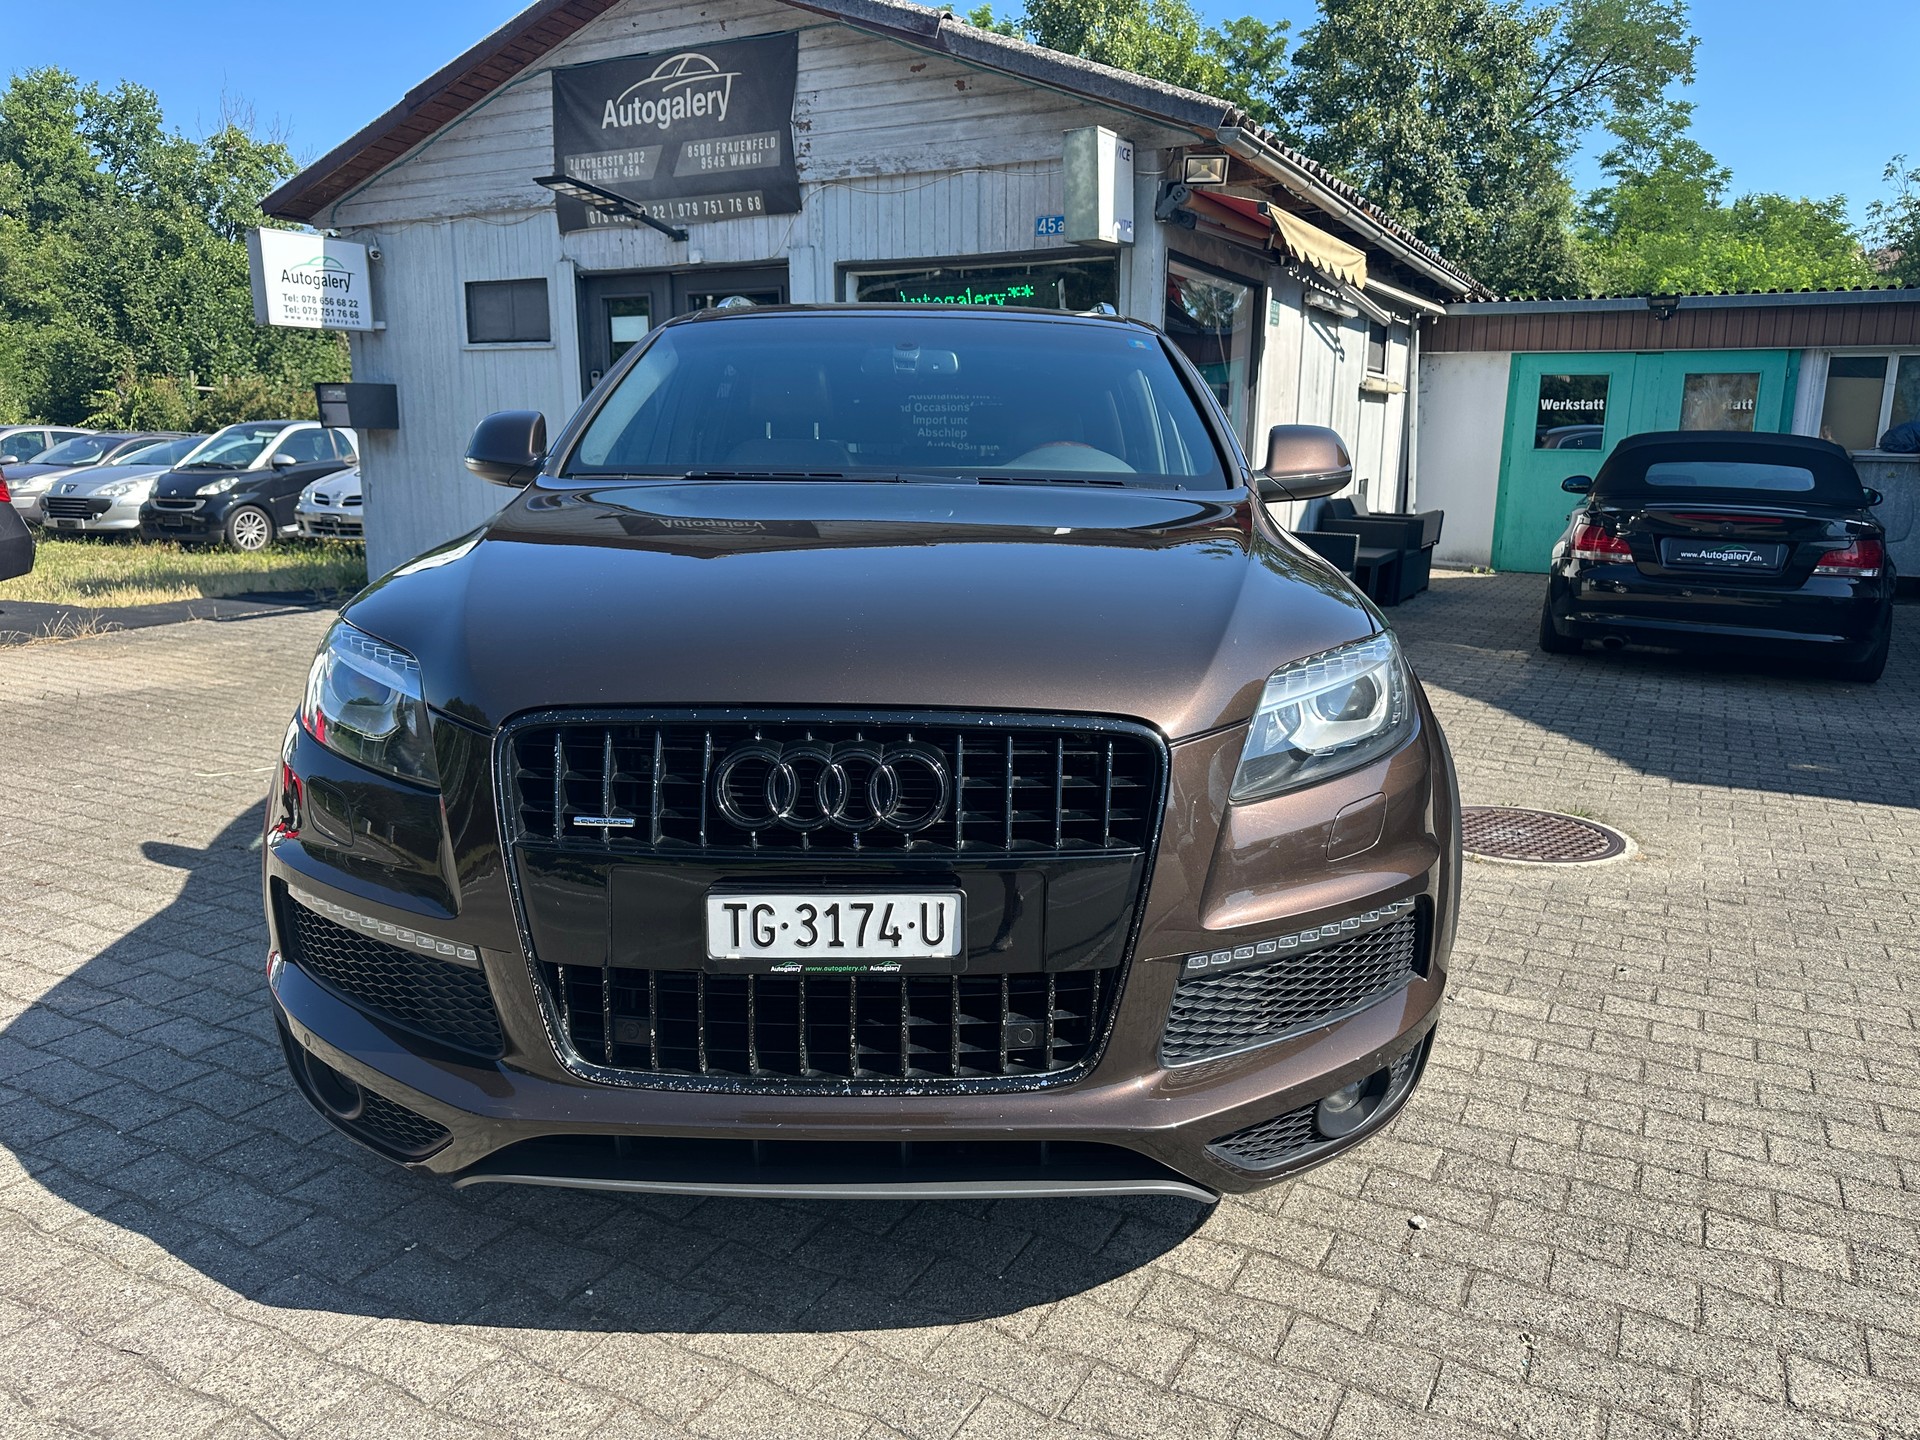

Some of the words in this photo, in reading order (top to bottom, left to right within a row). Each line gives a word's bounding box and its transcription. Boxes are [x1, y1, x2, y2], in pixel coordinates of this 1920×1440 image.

[602, 78, 733, 129] Autogalery
[687, 144, 711, 158] 8500
[716, 136, 776, 155] FRAUENFELD
[628, 151, 645, 164] 302
[701, 155, 725, 170] 9545
[730, 150, 762, 166] WÄNGI
[575, 168, 619, 181] WILERSTR
[623, 165, 640, 177] 45A
[653, 205, 665, 219] 22
[678, 202, 698, 217] 079
[704, 200, 723, 215] 751
[729, 197, 743, 212] 76
[748, 195, 762, 211] 68
[1038, 218, 1064, 233] 45a
[282, 269, 352, 293] Autogalery
[282, 293, 299, 303] Tel:
[301, 295, 317, 304] 078
[320, 297, 335, 306] 656
[337, 298, 347, 307] 68
[349, 299, 359, 309] 22
[284, 304, 301, 314] Tel:
[302, 307, 318, 315] 079
[321, 308, 335, 317] 751
[337, 309, 348, 318] 76
[349, 310, 360, 319] 68
[1540, 398, 1604, 411] Werkstatt
[913, 415, 947, 426] Import
[1681, 550, 1762, 562] www.Autogalery.ch
[771, 964, 802, 973] Autogalery
[805, 964, 868, 973] www.autogalery.ch
[870, 964, 901, 973] Autogalery
